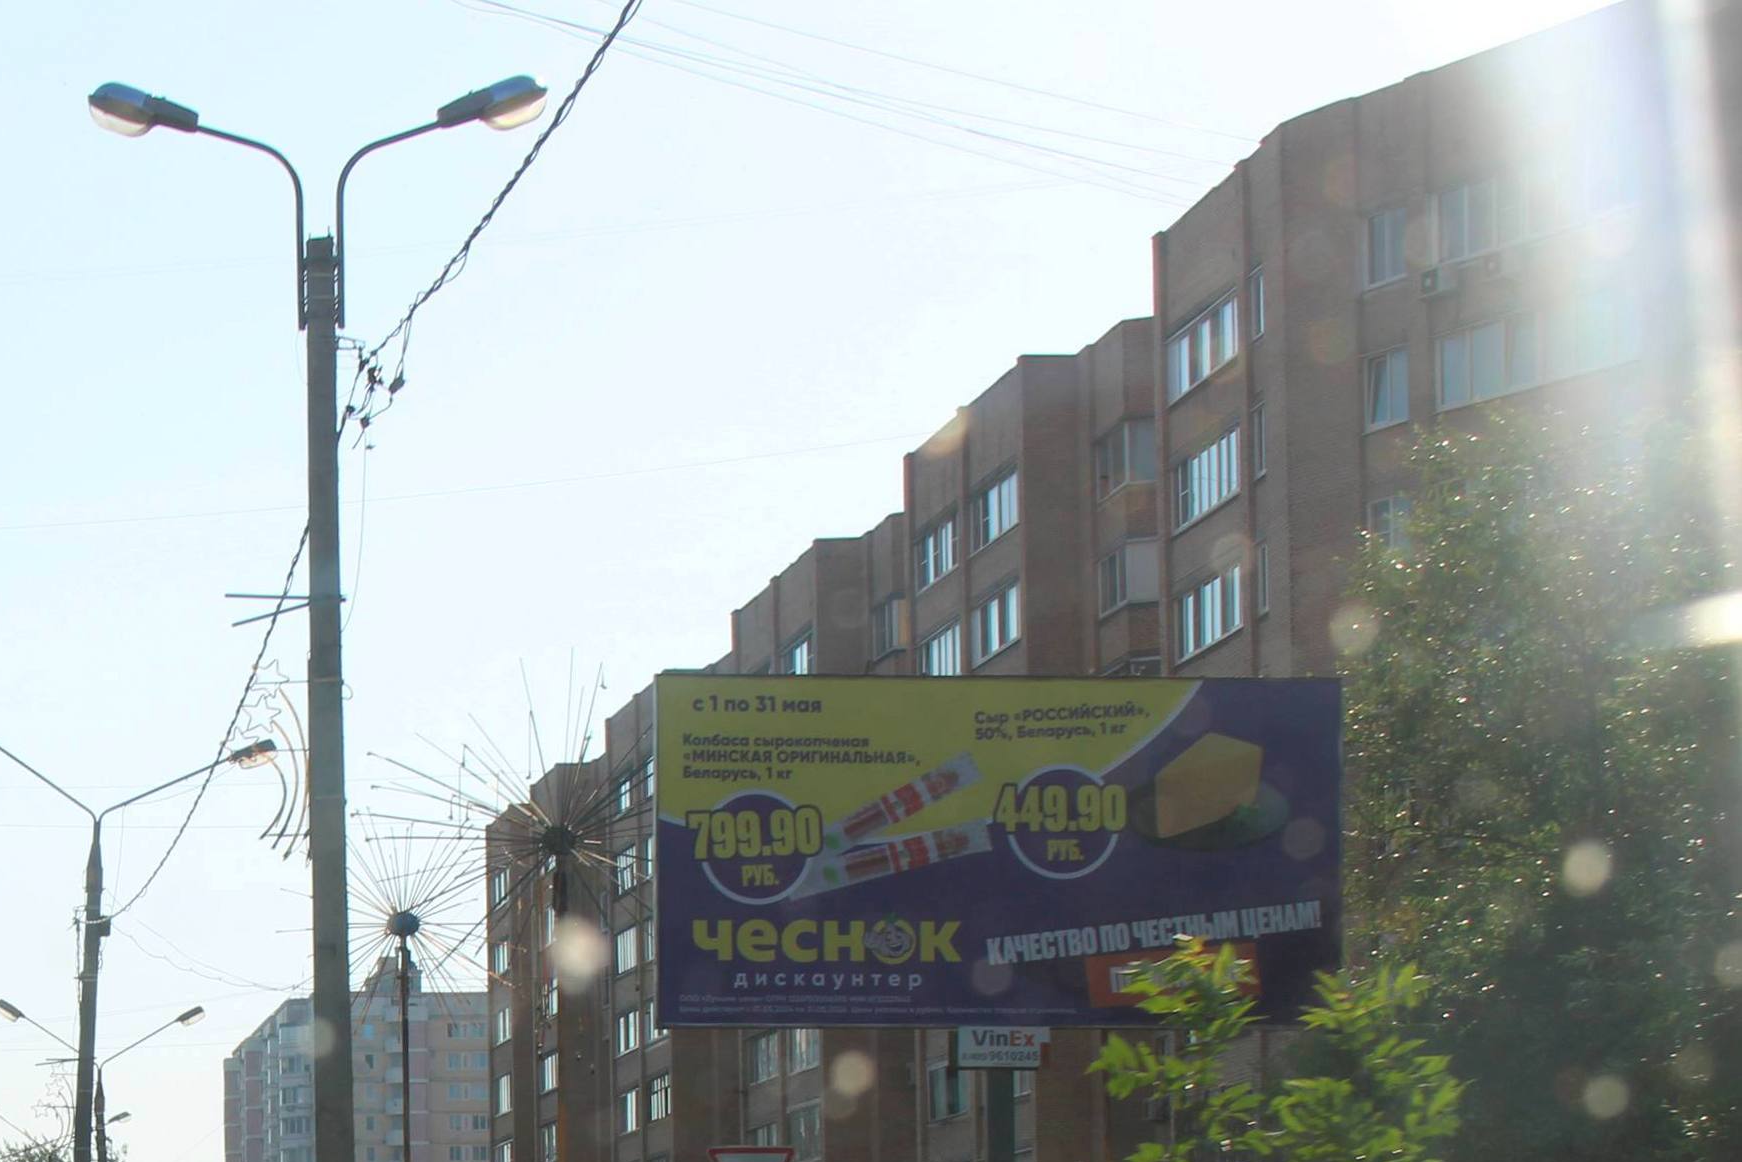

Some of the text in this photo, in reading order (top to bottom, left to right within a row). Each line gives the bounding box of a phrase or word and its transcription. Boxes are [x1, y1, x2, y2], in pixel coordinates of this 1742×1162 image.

[692, 695, 822, 713] с 1 по 31 мая
[974, 701, 1150, 726] Сыр «РОССИЙСКИЙ»,
[975, 721, 1126, 741] 50%, Беларусь, 1 кг
[682, 733, 869, 751] Колбаса сырокопченая
[683, 750, 921, 767] «МИНСКАЯ ОРИГИНАЛЬНАЯ»,
[682, 765, 793, 782] Беларусь, 1 кг
[994, 783, 1127, 832] 449.90
[687, 807, 822, 859] 799.90
[1046, 838, 1085, 862] РУБ.
[741, 864, 779, 887] РУБ.
[986, 901, 1322, 965] КАЧЕСТВО ПО ЧЕСТНЫМ ЦЕНАМ!
[734, 972, 922, 990] дискаунтер
[971, 1029, 1035, 1047] VinEx
